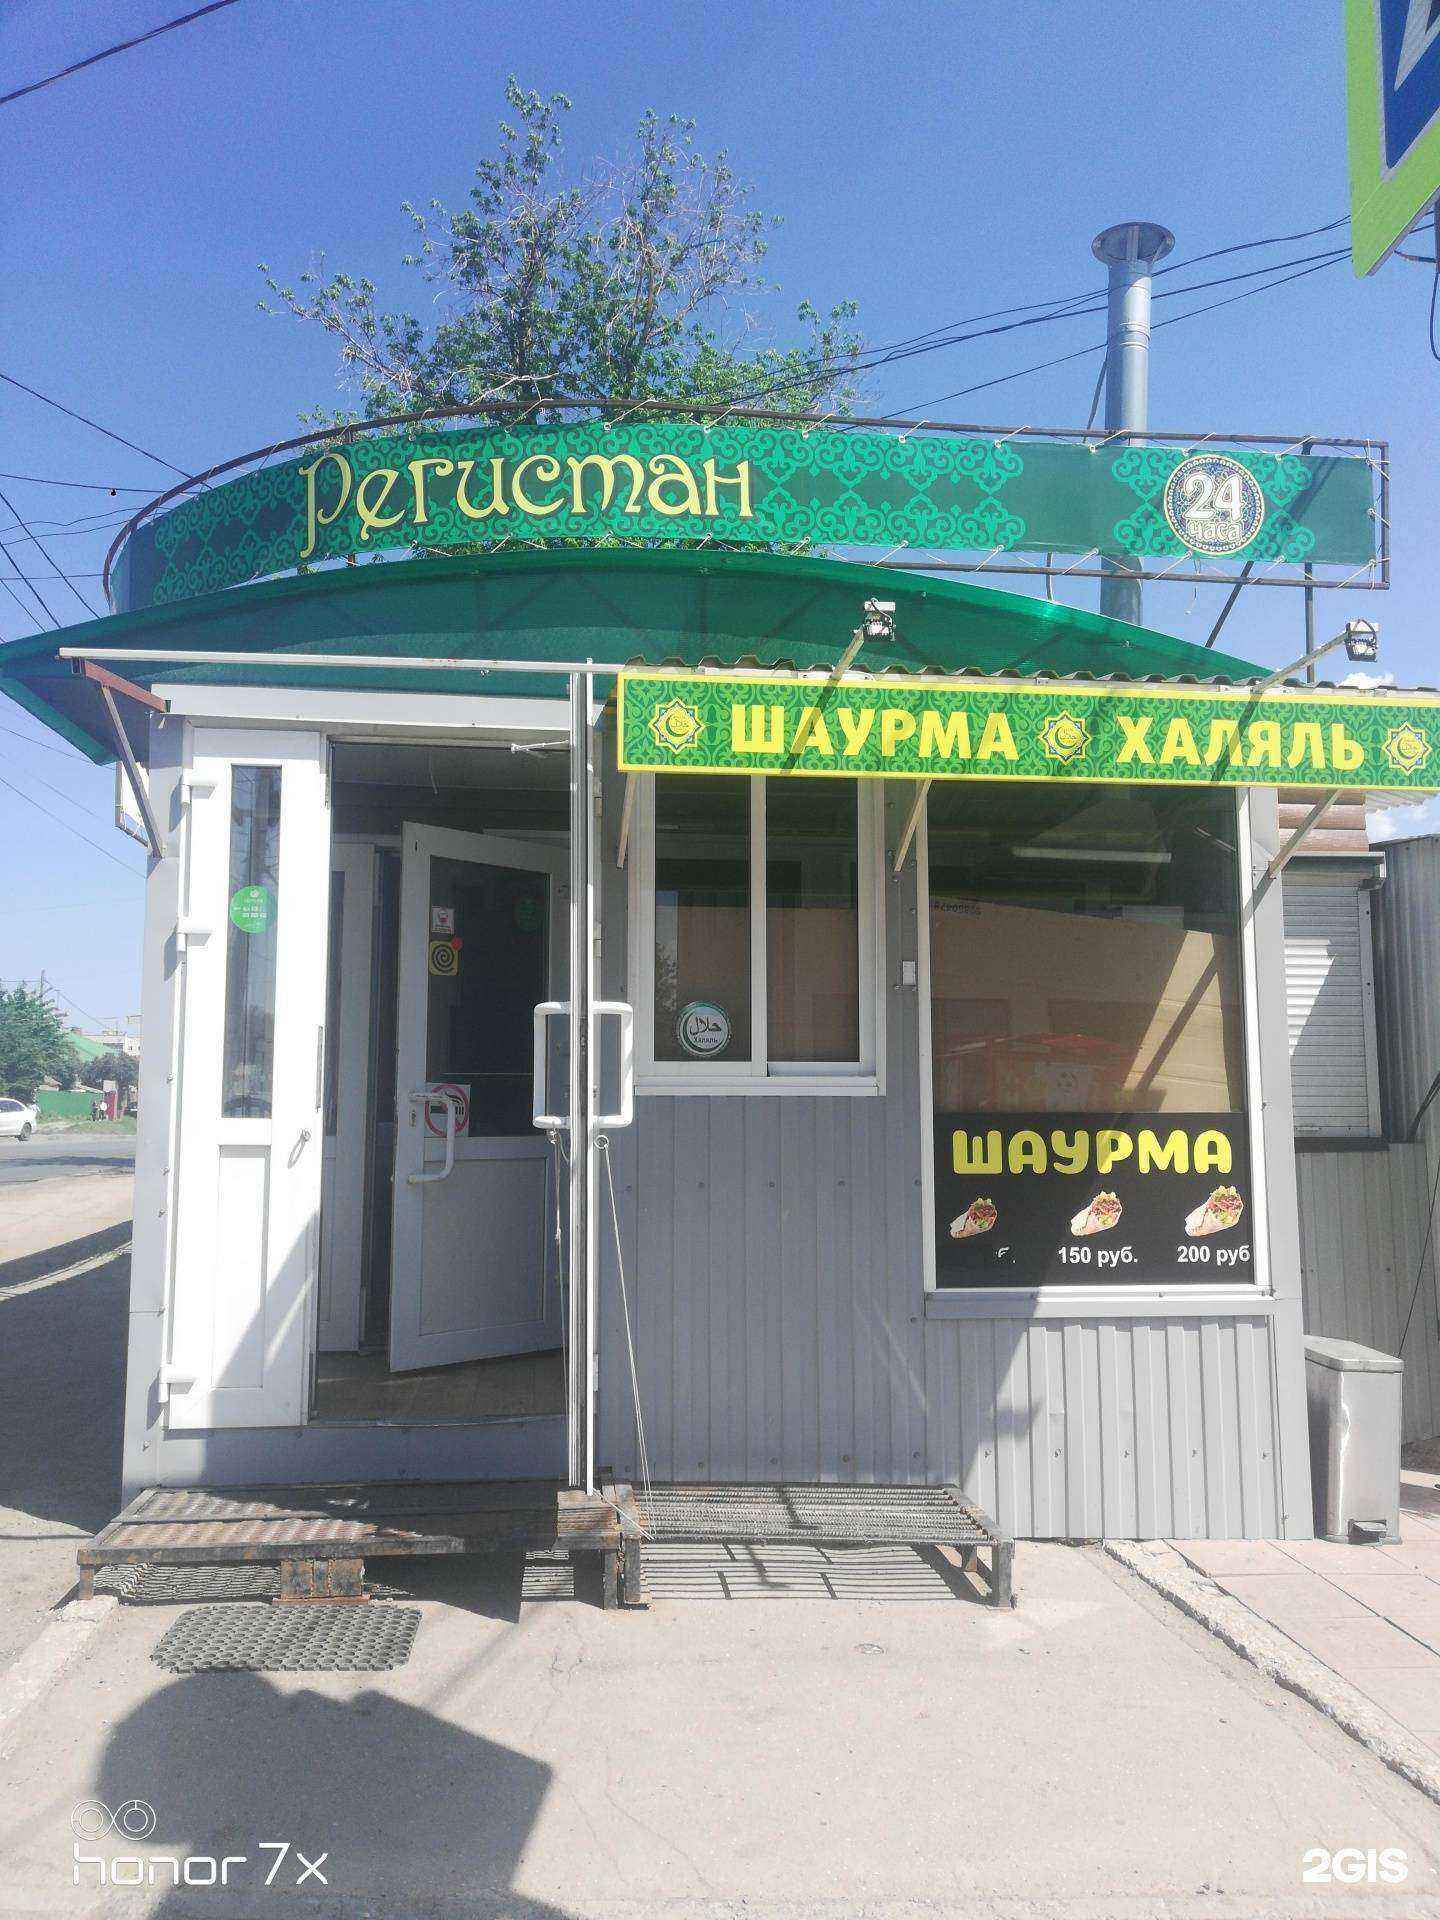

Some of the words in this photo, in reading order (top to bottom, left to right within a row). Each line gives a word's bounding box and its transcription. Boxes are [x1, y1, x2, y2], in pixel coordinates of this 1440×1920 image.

[299, 452, 752, 560] Регистан
[1182, 471, 1242, 521] 24
[731, 704, 1020, 761] ШАУРМА
[1115, 715, 1365, 771] ХАЛЯЛЬ
[951, 1129, 1232, 1175] ШАУРМА
[1058, 1246, 1091, 1264] 150
[1097, 1246, 1138, 1267] руб.
[1177, 1245, 1210, 1263] 200
